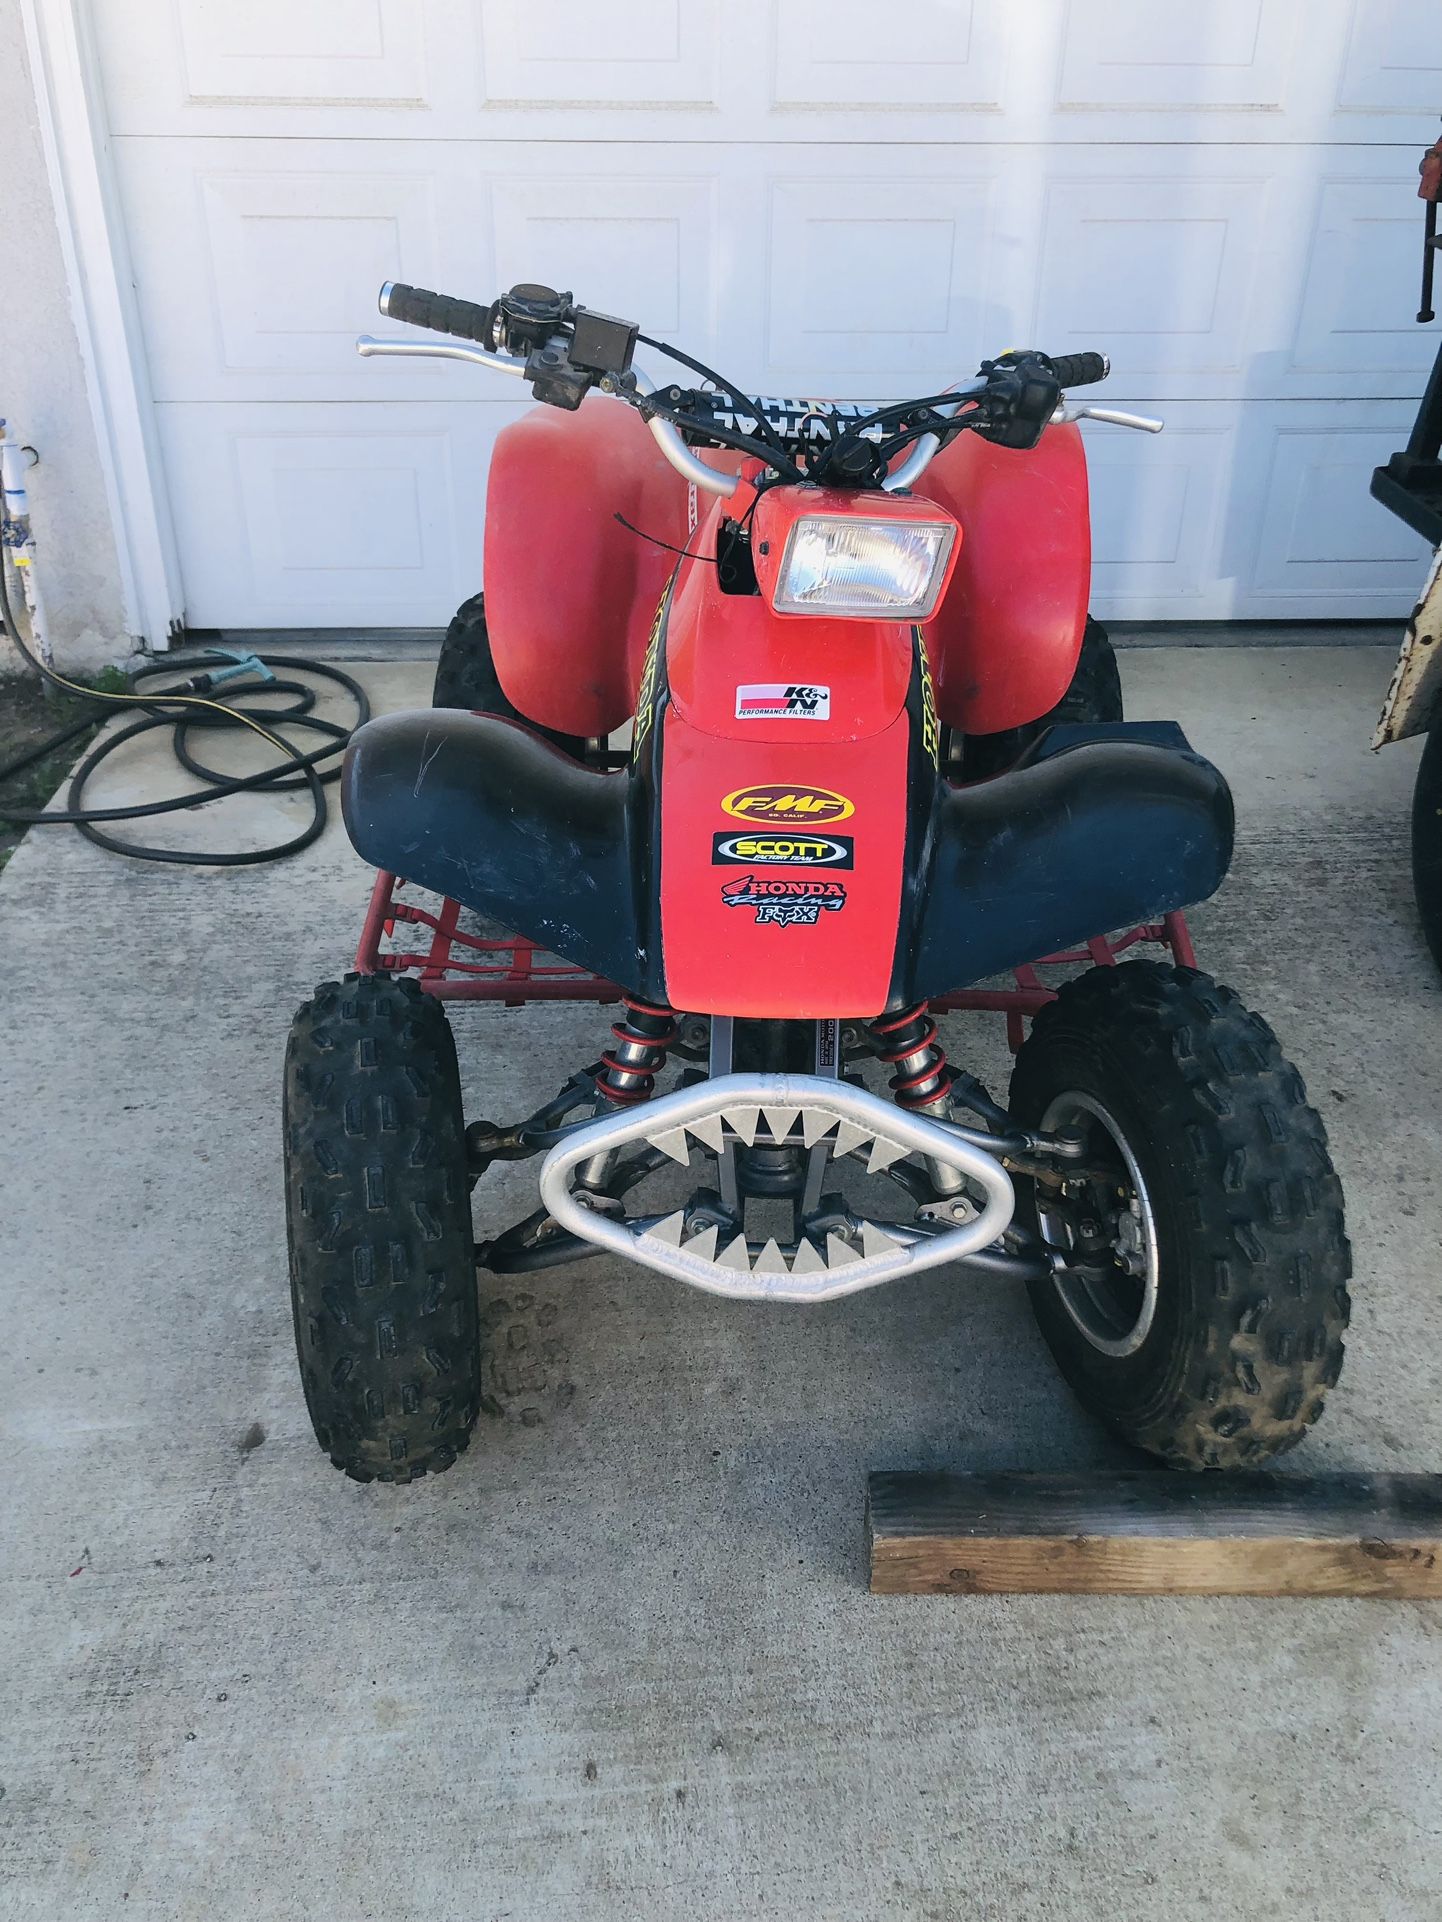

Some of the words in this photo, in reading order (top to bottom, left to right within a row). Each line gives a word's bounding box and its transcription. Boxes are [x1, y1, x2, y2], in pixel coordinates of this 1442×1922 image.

[738, 708, 787, 716] PERFORMANCE
[788, 708, 816, 716] FILTERS
[731, 794, 845, 813] FMF
[736, 841, 829, 857] SCOTT
[753, 853, 789, 861] FACTORY
[748, 882, 844, 897] HONDA
[723, 892, 844, 910] Racing
[755, 905, 819, 926] FOX
